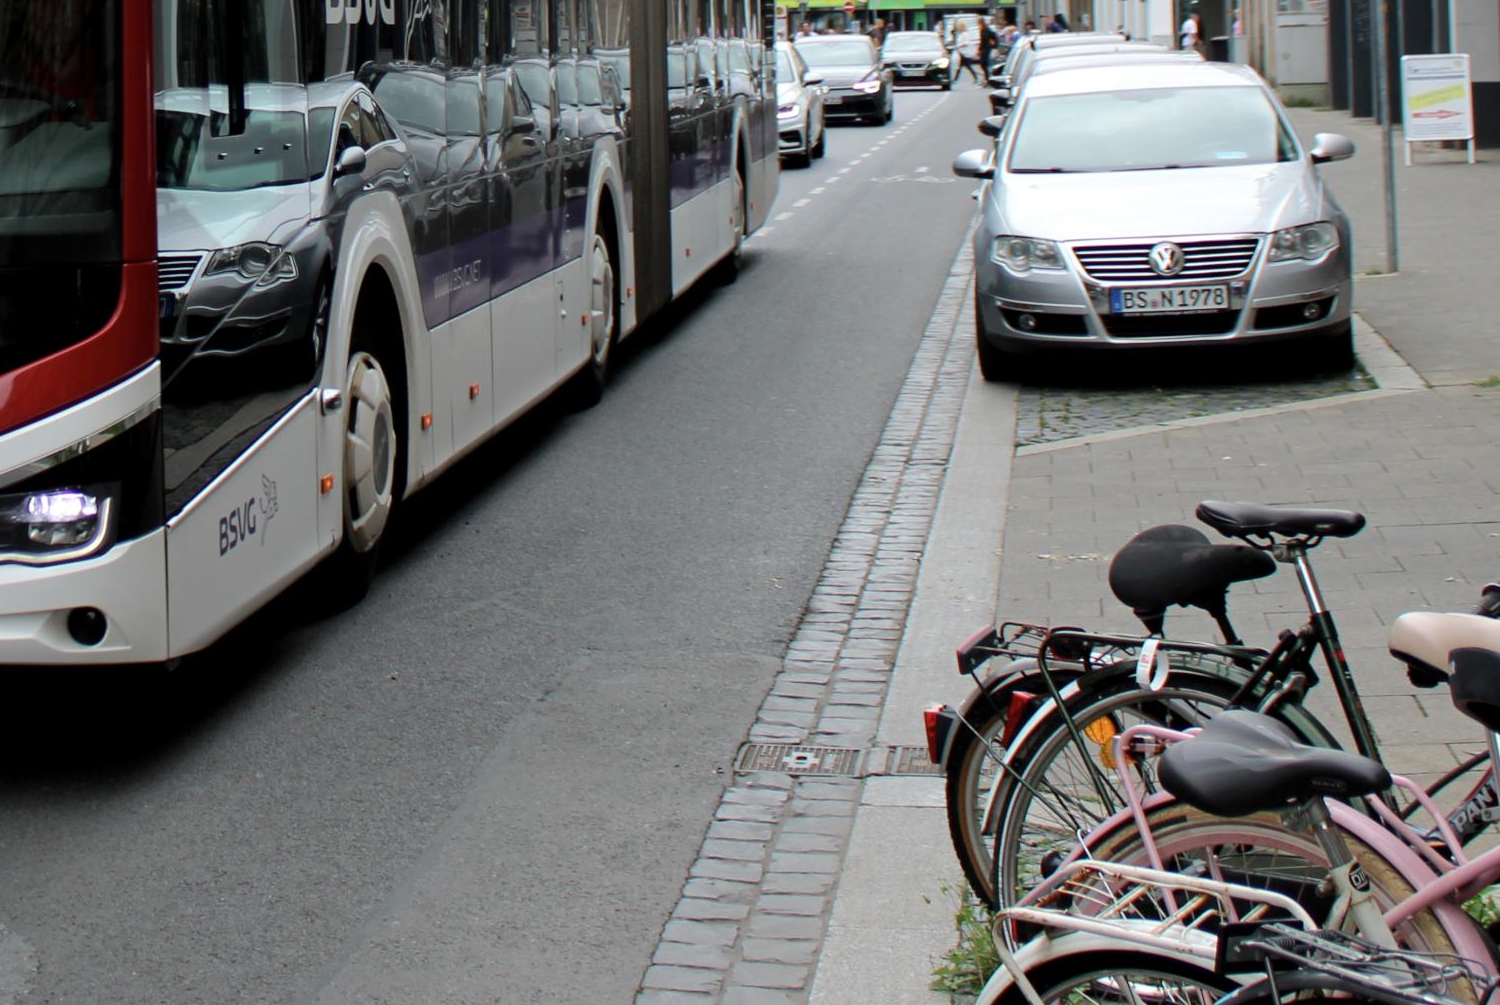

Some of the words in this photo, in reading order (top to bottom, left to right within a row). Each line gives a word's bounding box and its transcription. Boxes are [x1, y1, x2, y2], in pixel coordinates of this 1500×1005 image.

[1123, 292, 1148, 309] BS
[1160, 290, 1173, 307] N
[1177, 287, 1225, 307] 1978
[219, 497, 256, 556] BSVG
